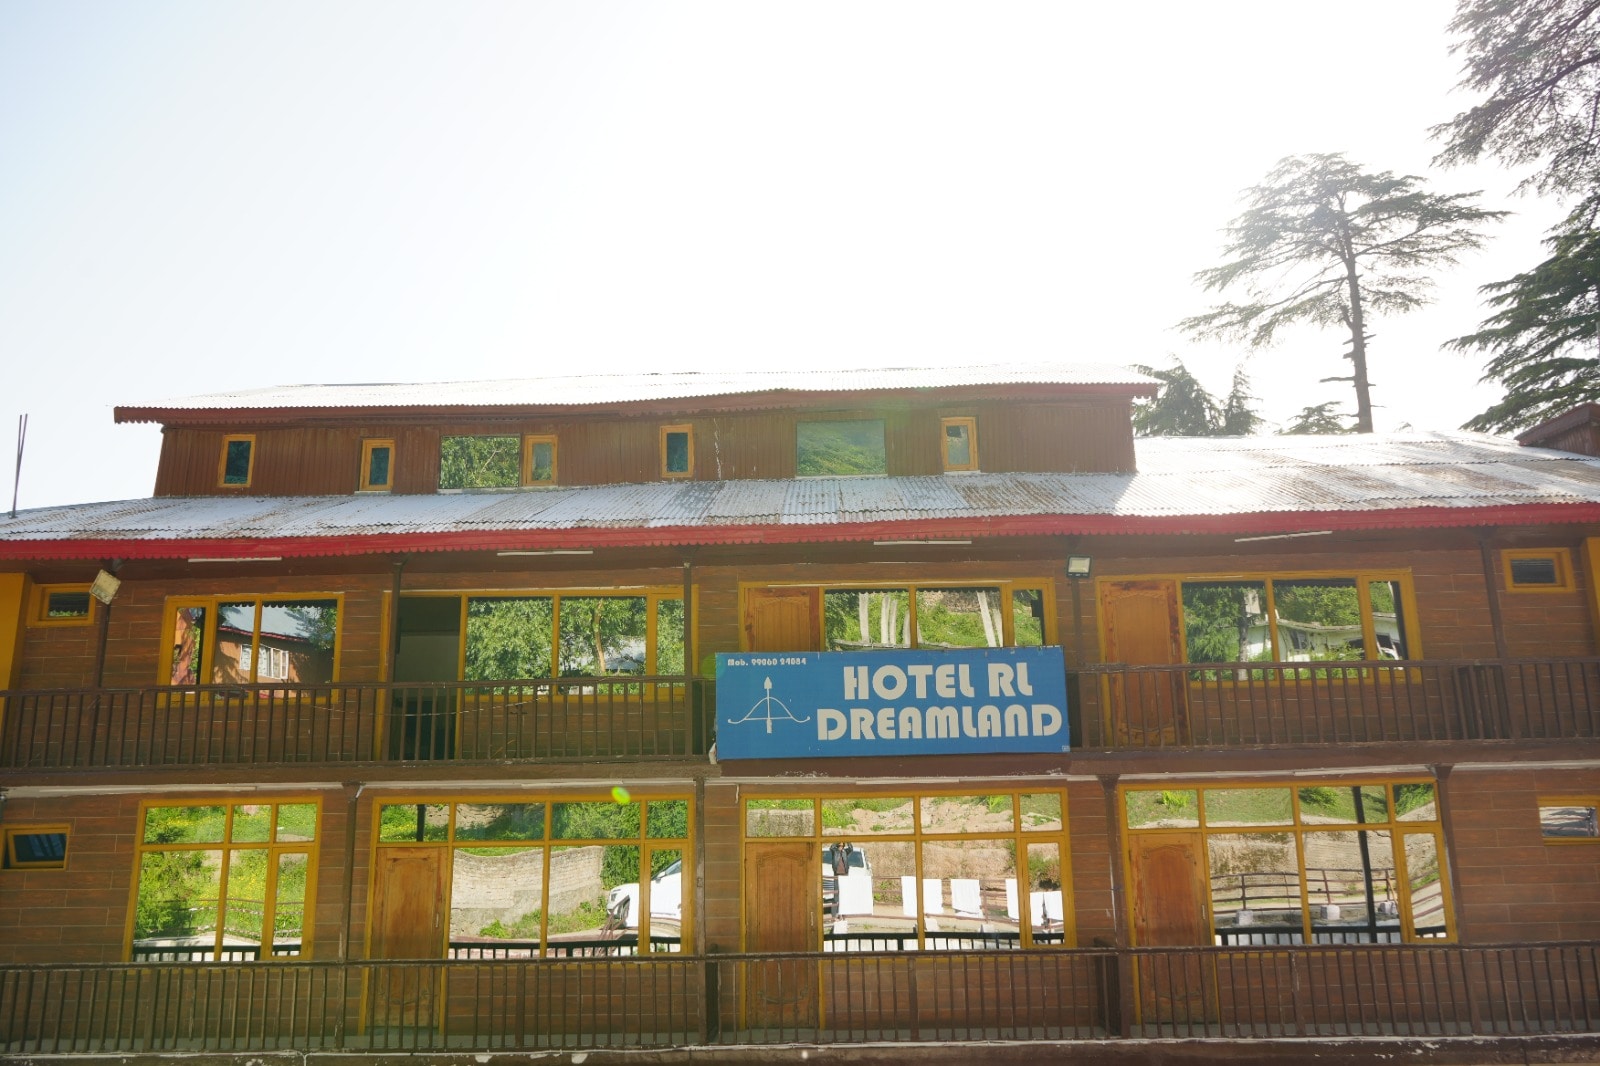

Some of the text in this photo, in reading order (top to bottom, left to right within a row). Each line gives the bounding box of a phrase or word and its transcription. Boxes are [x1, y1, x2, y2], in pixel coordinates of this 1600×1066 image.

[843, 662, 1033, 700] HOTEL RL
[817, 704, 1062, 740] DREAMLAND
